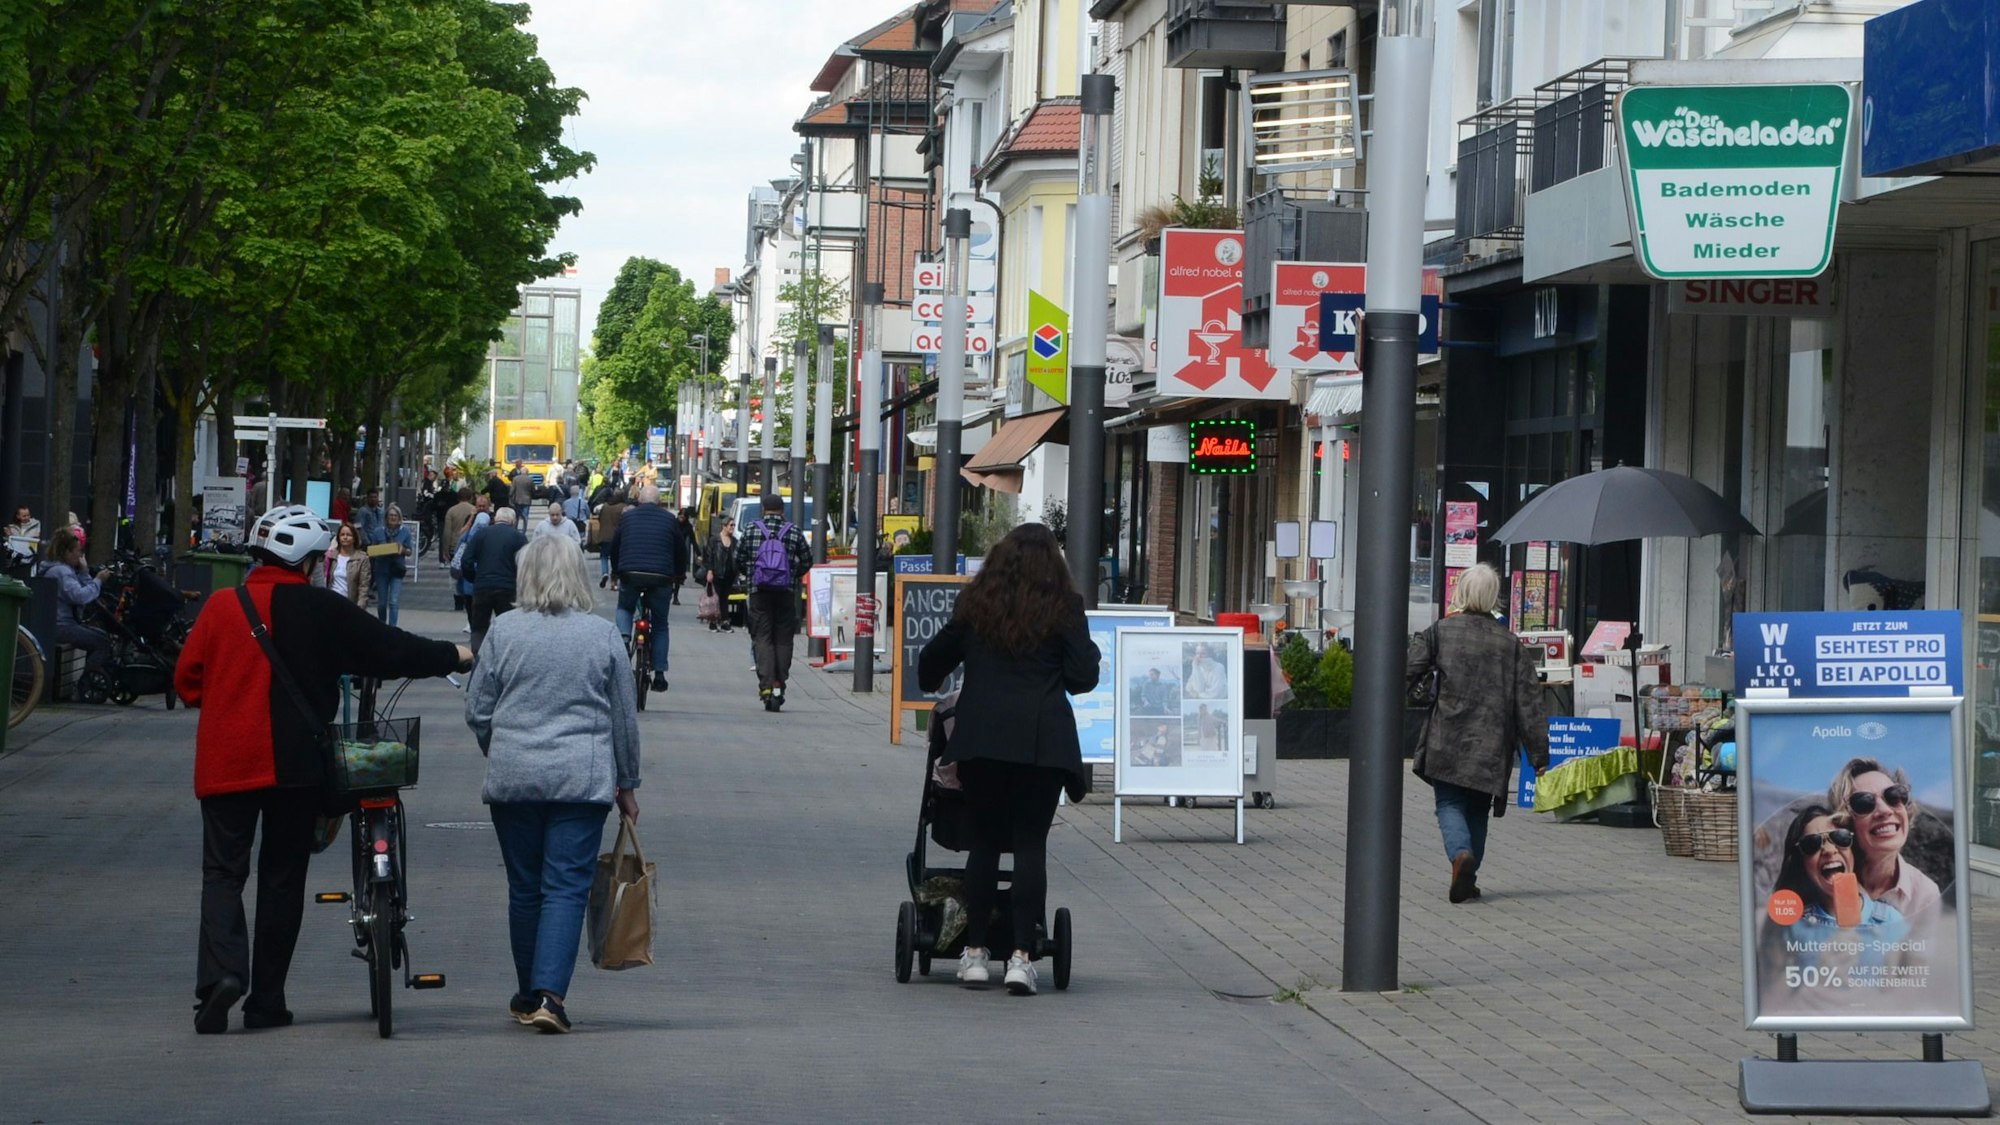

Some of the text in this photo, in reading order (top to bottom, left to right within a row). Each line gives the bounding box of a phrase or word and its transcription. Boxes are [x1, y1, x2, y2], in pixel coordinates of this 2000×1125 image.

[1660, 181, 1811, 197] Bademoden
[1685, 212, 1785, 228] Wäsche
[1693, 243, 1781, 259] Mieder
[1169, 265, 1200, 278] alfred
[1202, 267, 1232, 278] nobel
[1684, 279, 1819, 305] SINGER
[1194, 437, 1251, 456] Nails
[903, 588, 961, 613] ANGE
[1760, 623, 1789, 646] W
[1852, 621, 1908, 632] JETZT ZUM
[1820, 638, 1940, 654] SEHTEST PRO
[1821, 665, 1941, 682] BEI APOLLO
[1812, 725, 1852, 739] Apollo
[1775, 907, 1797, 916] 11.05.
[1786, 939, 1926, 955] Muttertags-Special
[1785, 966, 1842, 988] 50%
[1848, 966, 1930, 976] AUF DIE ZWEITE
[1848, 977, 1928, 988] SONNENBRILLE
